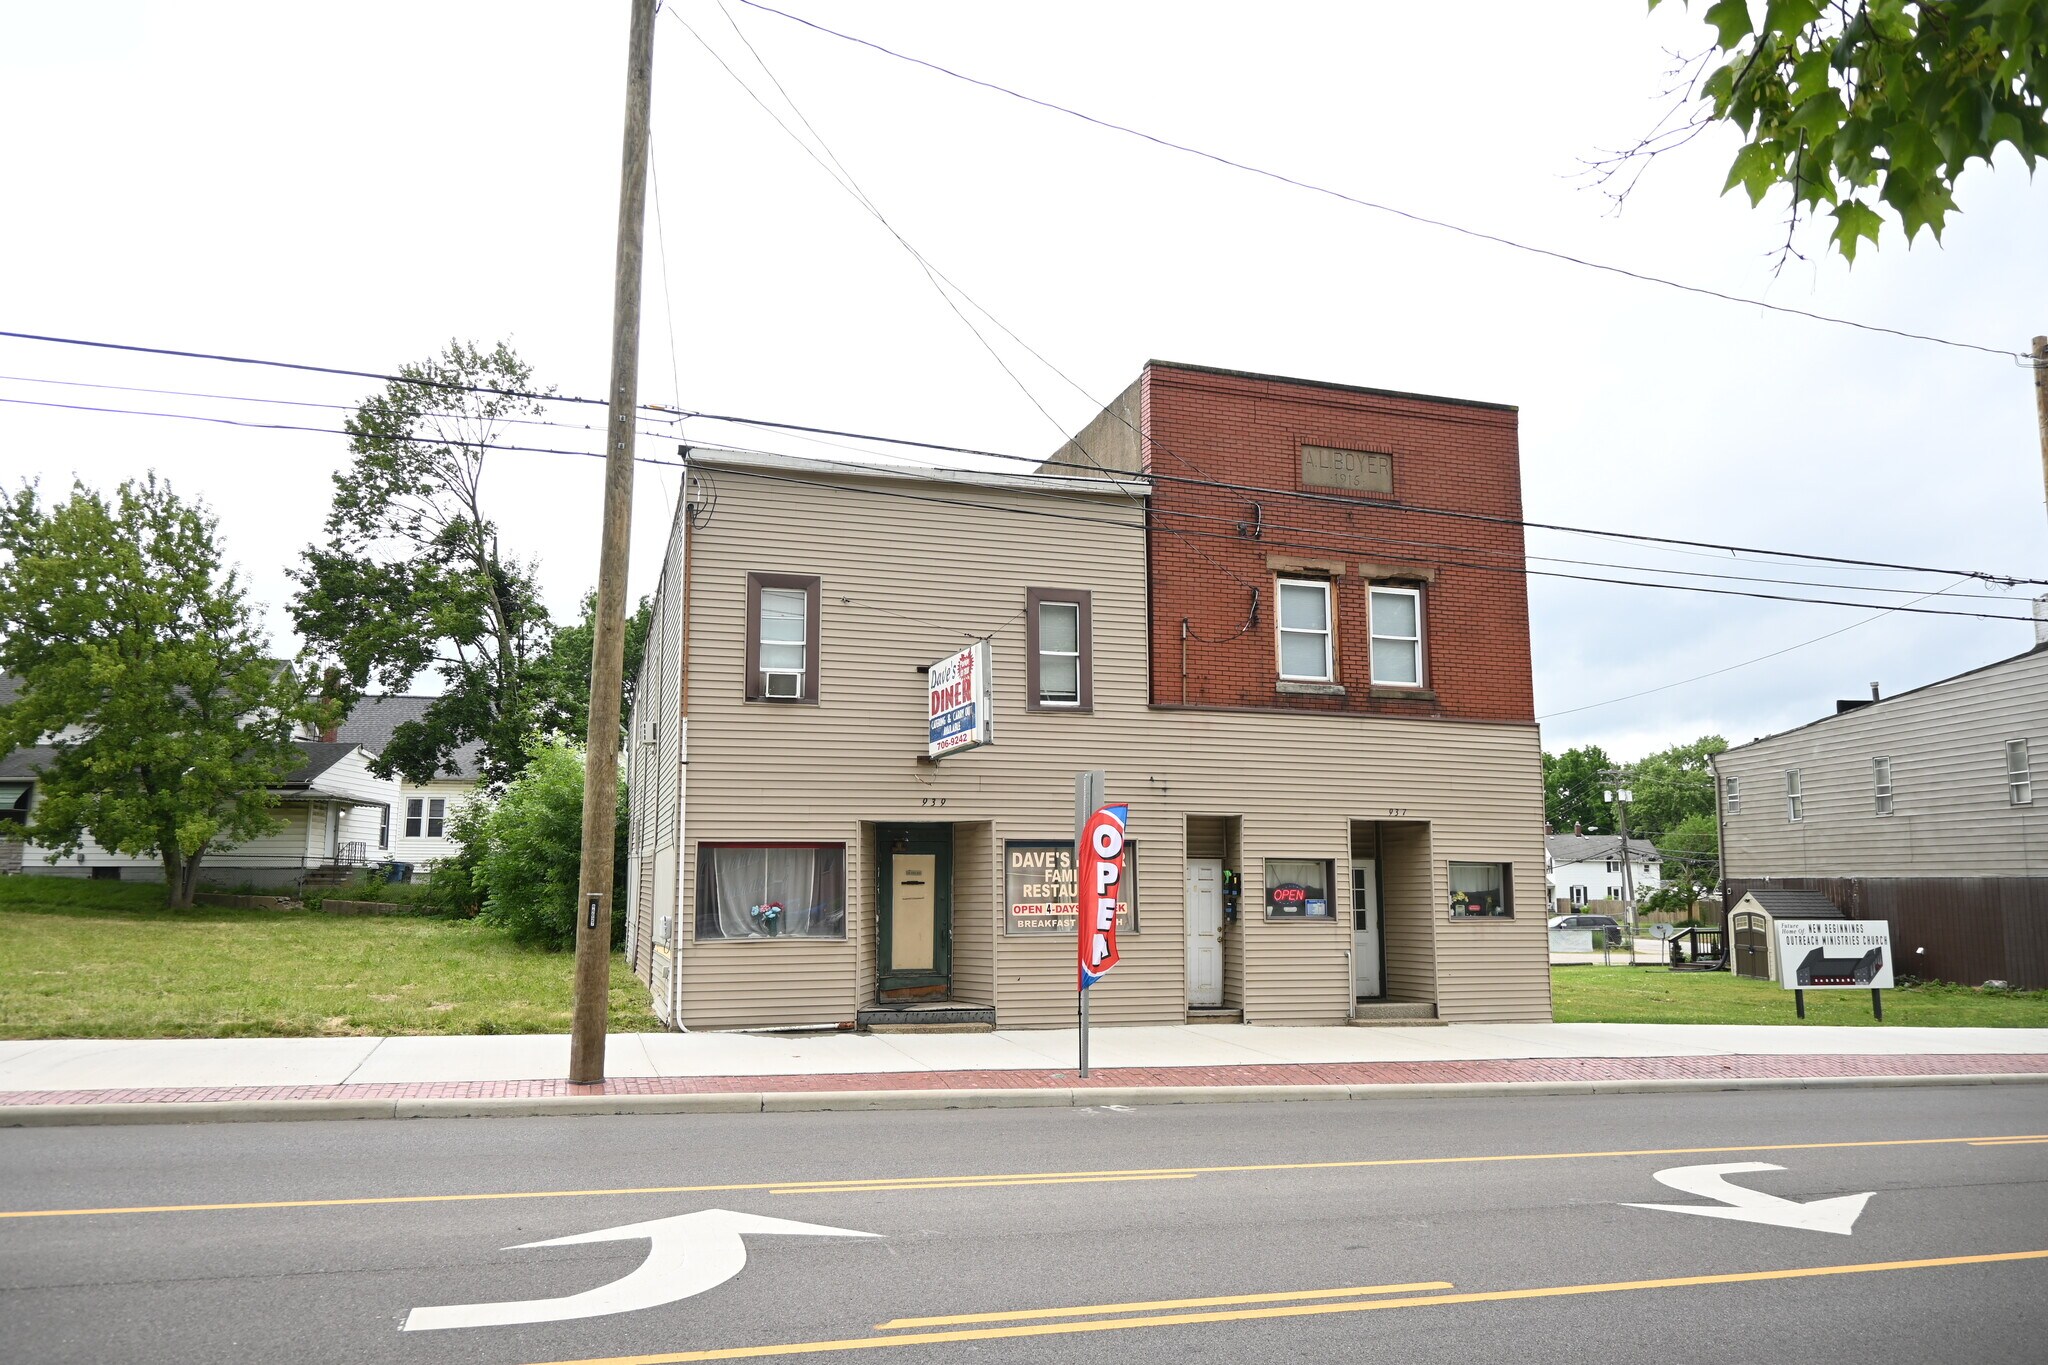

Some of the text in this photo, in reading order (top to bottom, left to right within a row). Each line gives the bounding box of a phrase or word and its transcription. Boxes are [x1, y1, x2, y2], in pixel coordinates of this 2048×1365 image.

[931, 661, 956, 689] Dave's
[931, 680, 972, 716] DINER
[937, 733, 968, 750] 706-9242
[922, 797, 946, 808] 939
[1388, 808, 1407, 817] 937
[1012, 851, 1070, 868] DAVE'S
[1045, 869, 1077, 883] FAMI
[1023, 884, 1078, 898] RESTAU
[1273, 889, 1305, 901] OPEN
[1013, 905, 1043, 915] OPEN
[1017, 919, 1076, 928] BREAKFAST
[1808, 923, 1865, 934] NEW BEGINNINGS
[1786, 935, 1888, 946] OUTREACH MINISTRIES CHURCH
